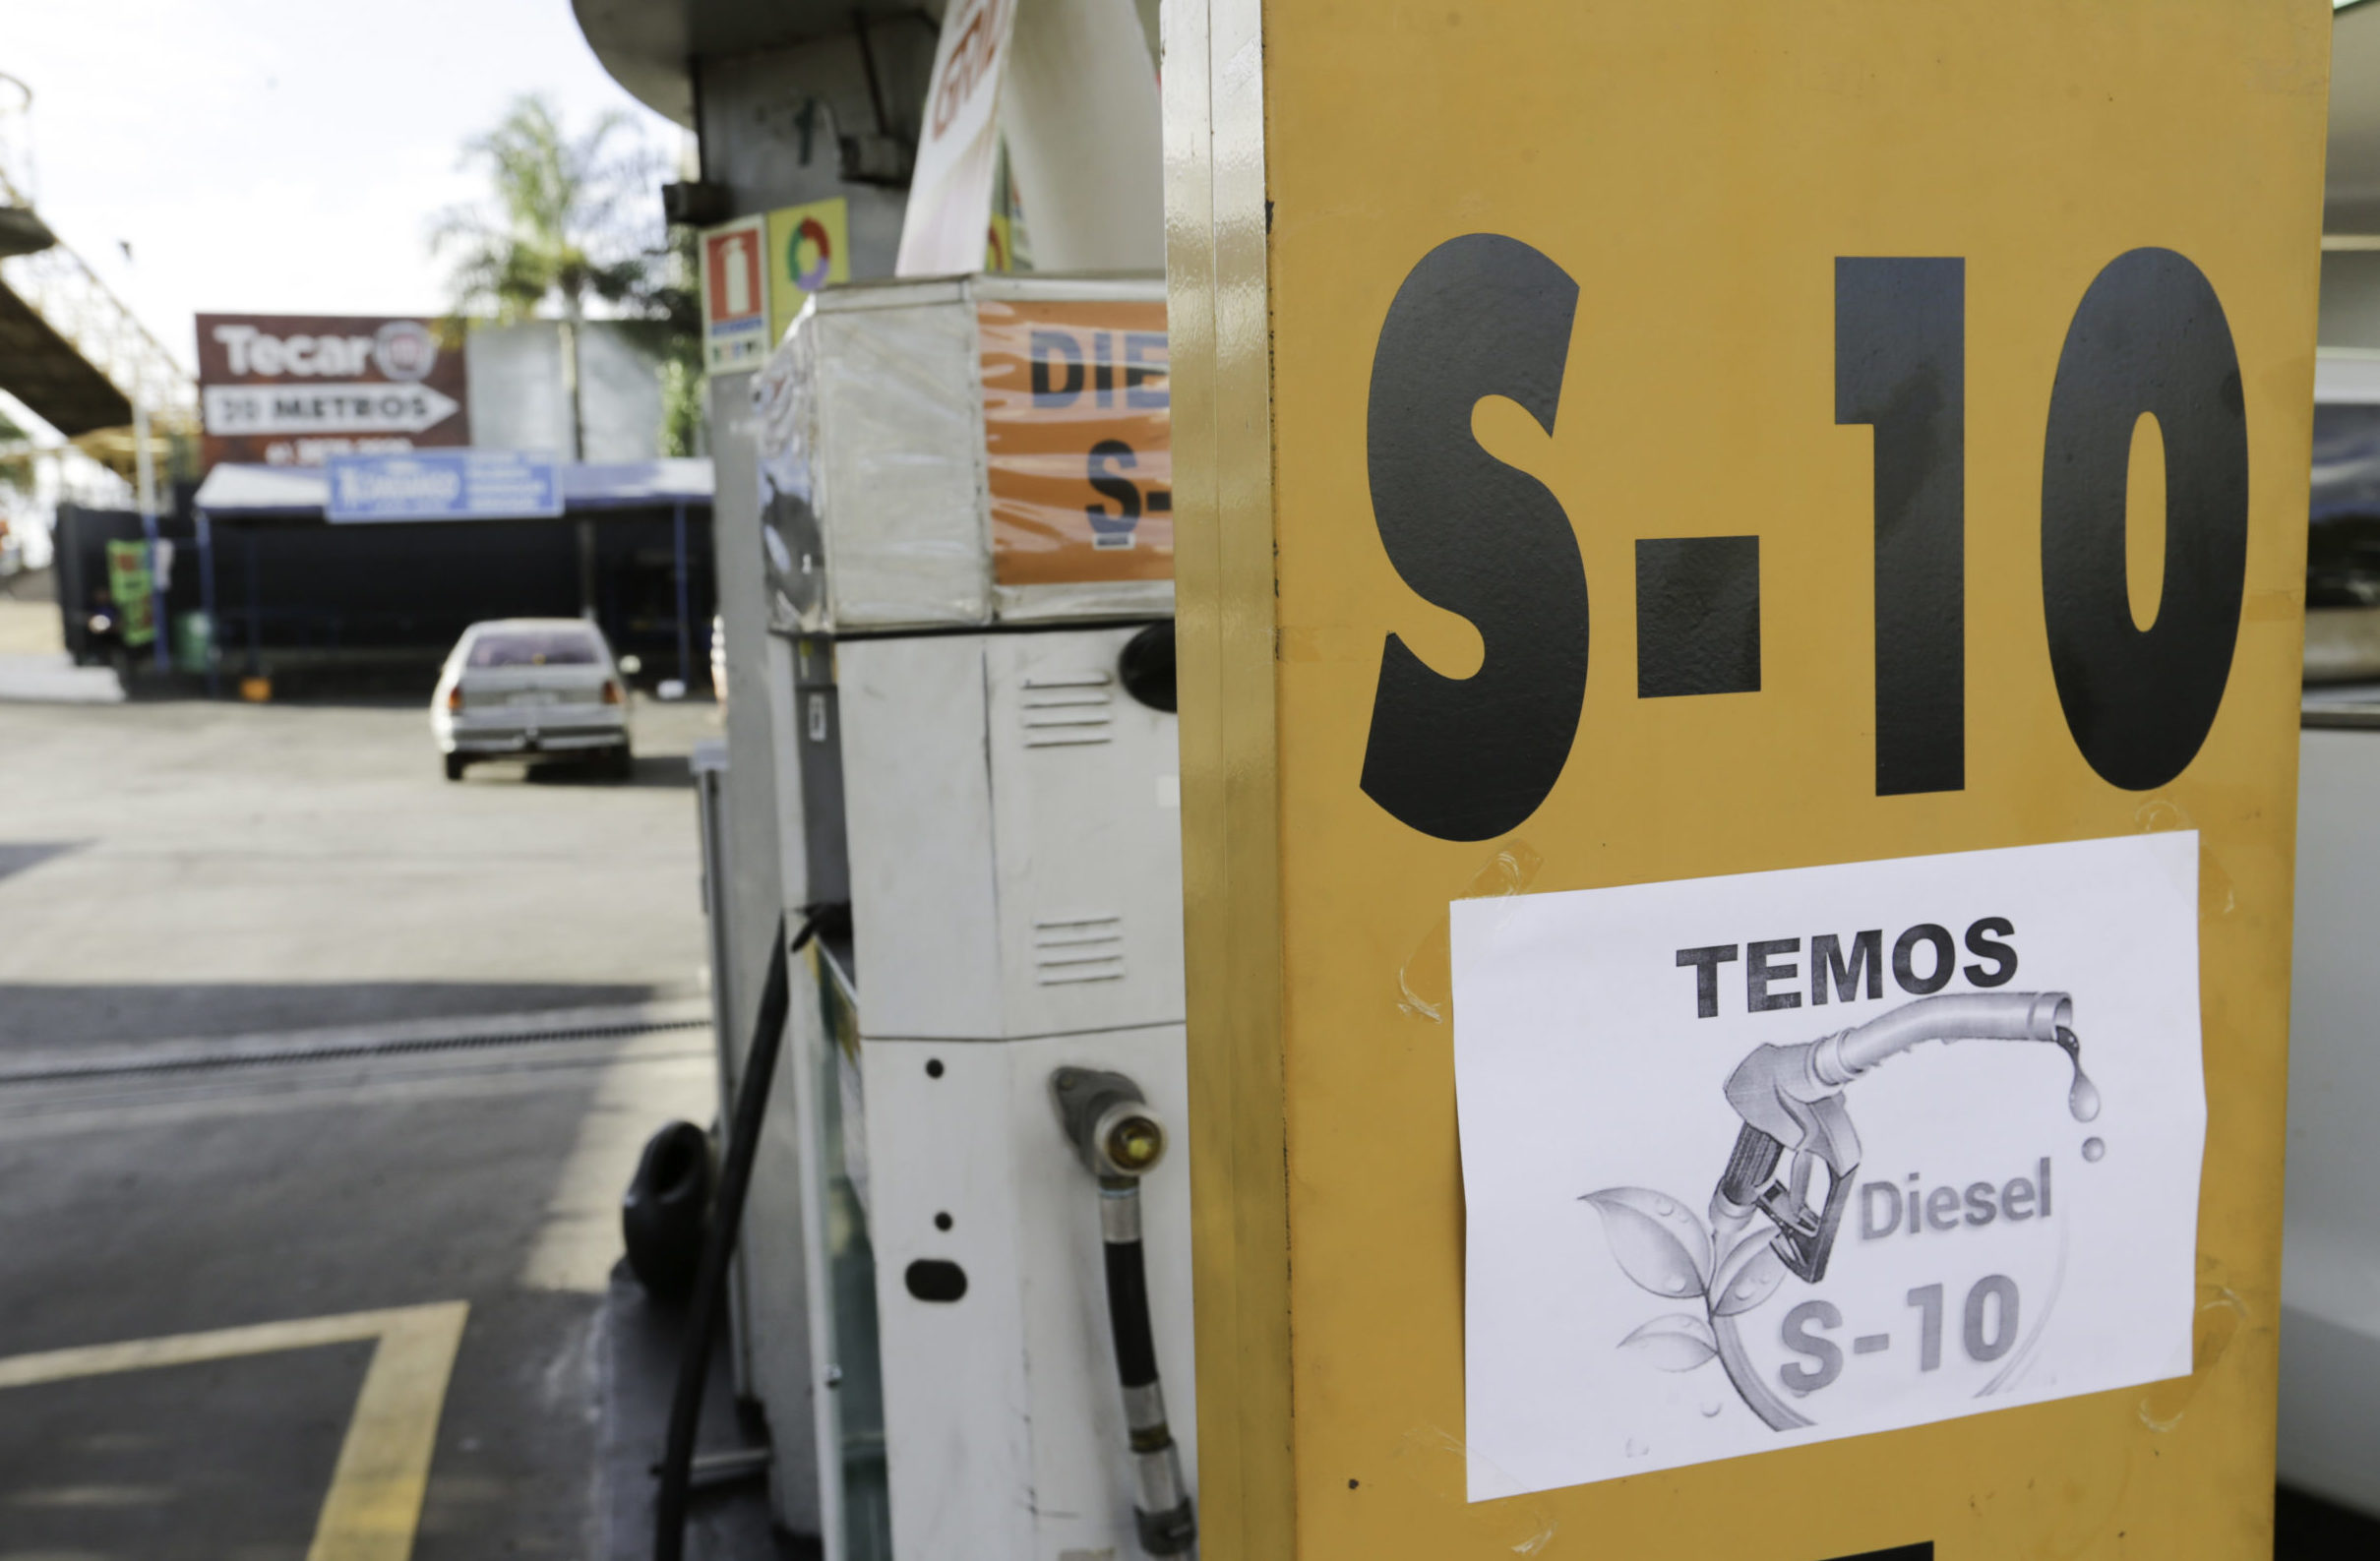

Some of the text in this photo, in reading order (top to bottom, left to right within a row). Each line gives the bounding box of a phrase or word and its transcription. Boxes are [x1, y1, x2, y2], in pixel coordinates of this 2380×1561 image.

[214, 324, 377, 376] Tecar
[273, 394, 428, 420] METROS
[1359, 232, 2249, 843] S-10
[1676, 916, 2019, 1019] TEMOS
[1861, 1156, 2052, 1241] Diesel
[1779, 1273, 2021, 1393] S-10
